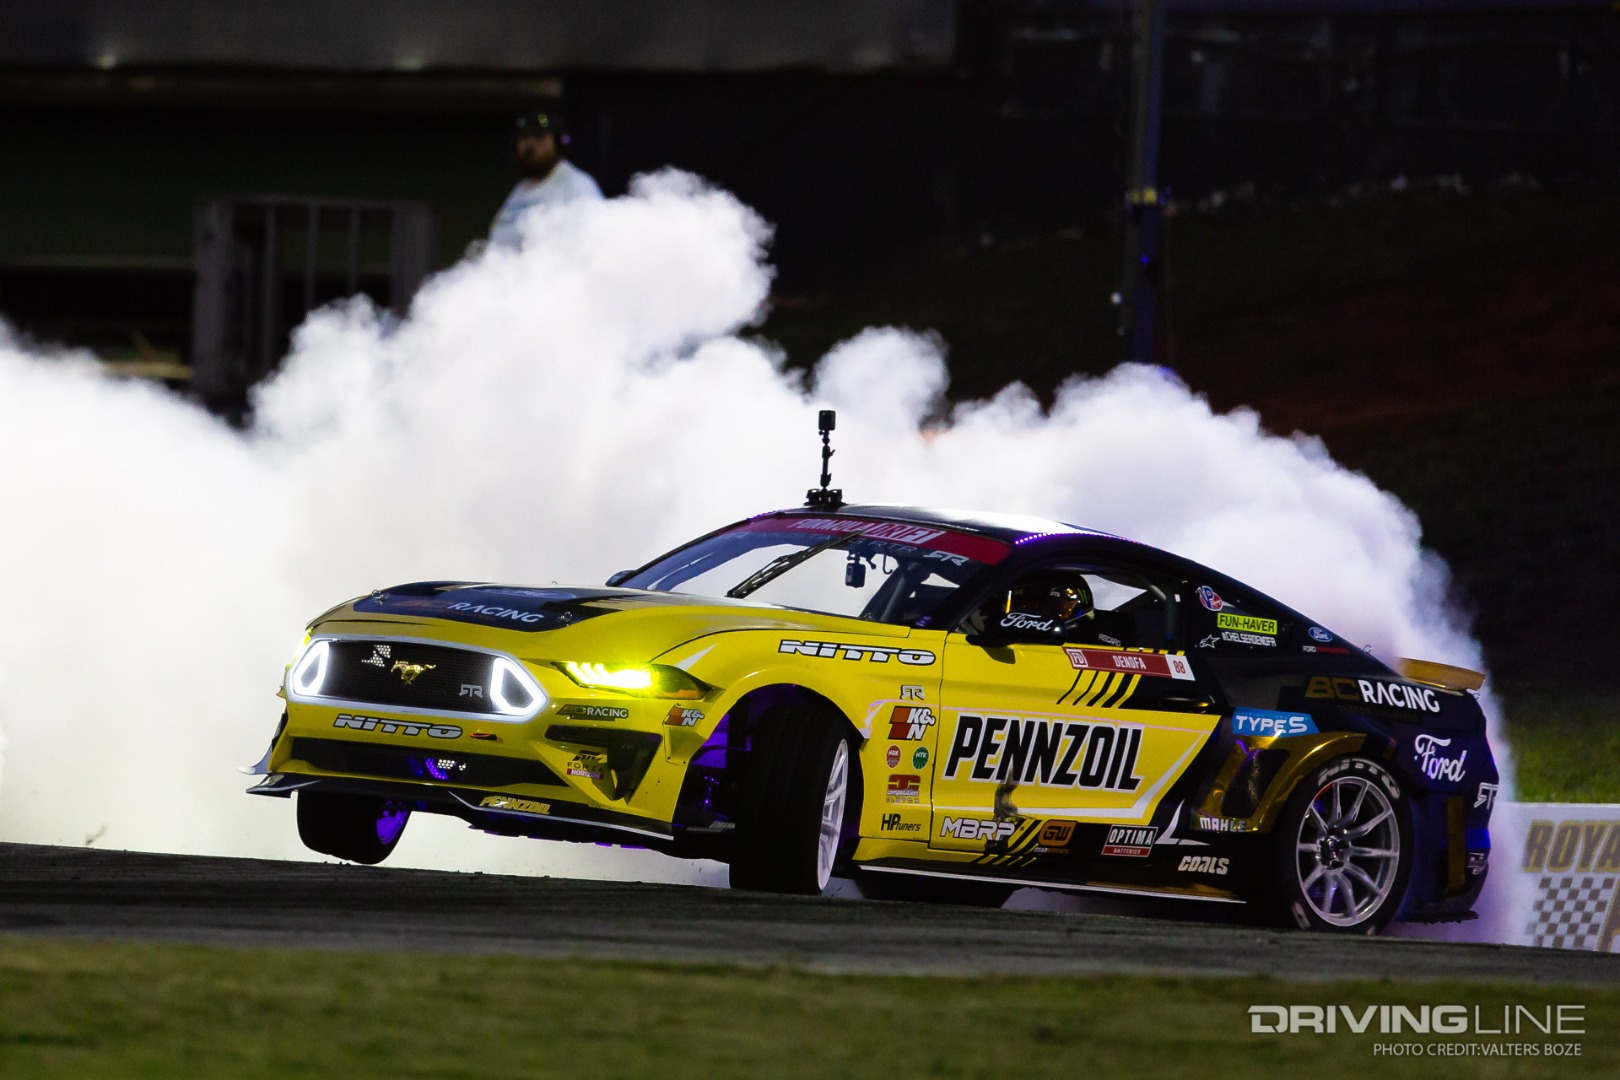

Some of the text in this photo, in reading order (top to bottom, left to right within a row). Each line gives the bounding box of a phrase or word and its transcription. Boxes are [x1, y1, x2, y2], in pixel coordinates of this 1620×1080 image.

[862, 522, 947, 544] DRIFT
[448, 602, 545, 623] RACING
[1000, 612, 1054, 632] Ford
[1218, 615, 1275, 632] FUN-HAVER
[778, 639, 936, 666] NITTO
[1112, 655, 1147, 670] DENOFA
[1173, 660, 1186, 674] 88
[1357, 679, 1441, 713] RACING
[586, 706, 628, 718] RACING
[333, 713, 463, 739] NITTO
[942, 711, 1145, 793] PENNZOIL
[1414, 733, 1467, 782] Ford
[478, 795, 552, 815] PENNZOIL
[940, 818, 1016, 842] MBRP
[1200, 817, 1247, 833] MAHLE
[1108, 828, 1155, 846] OPTIMA
